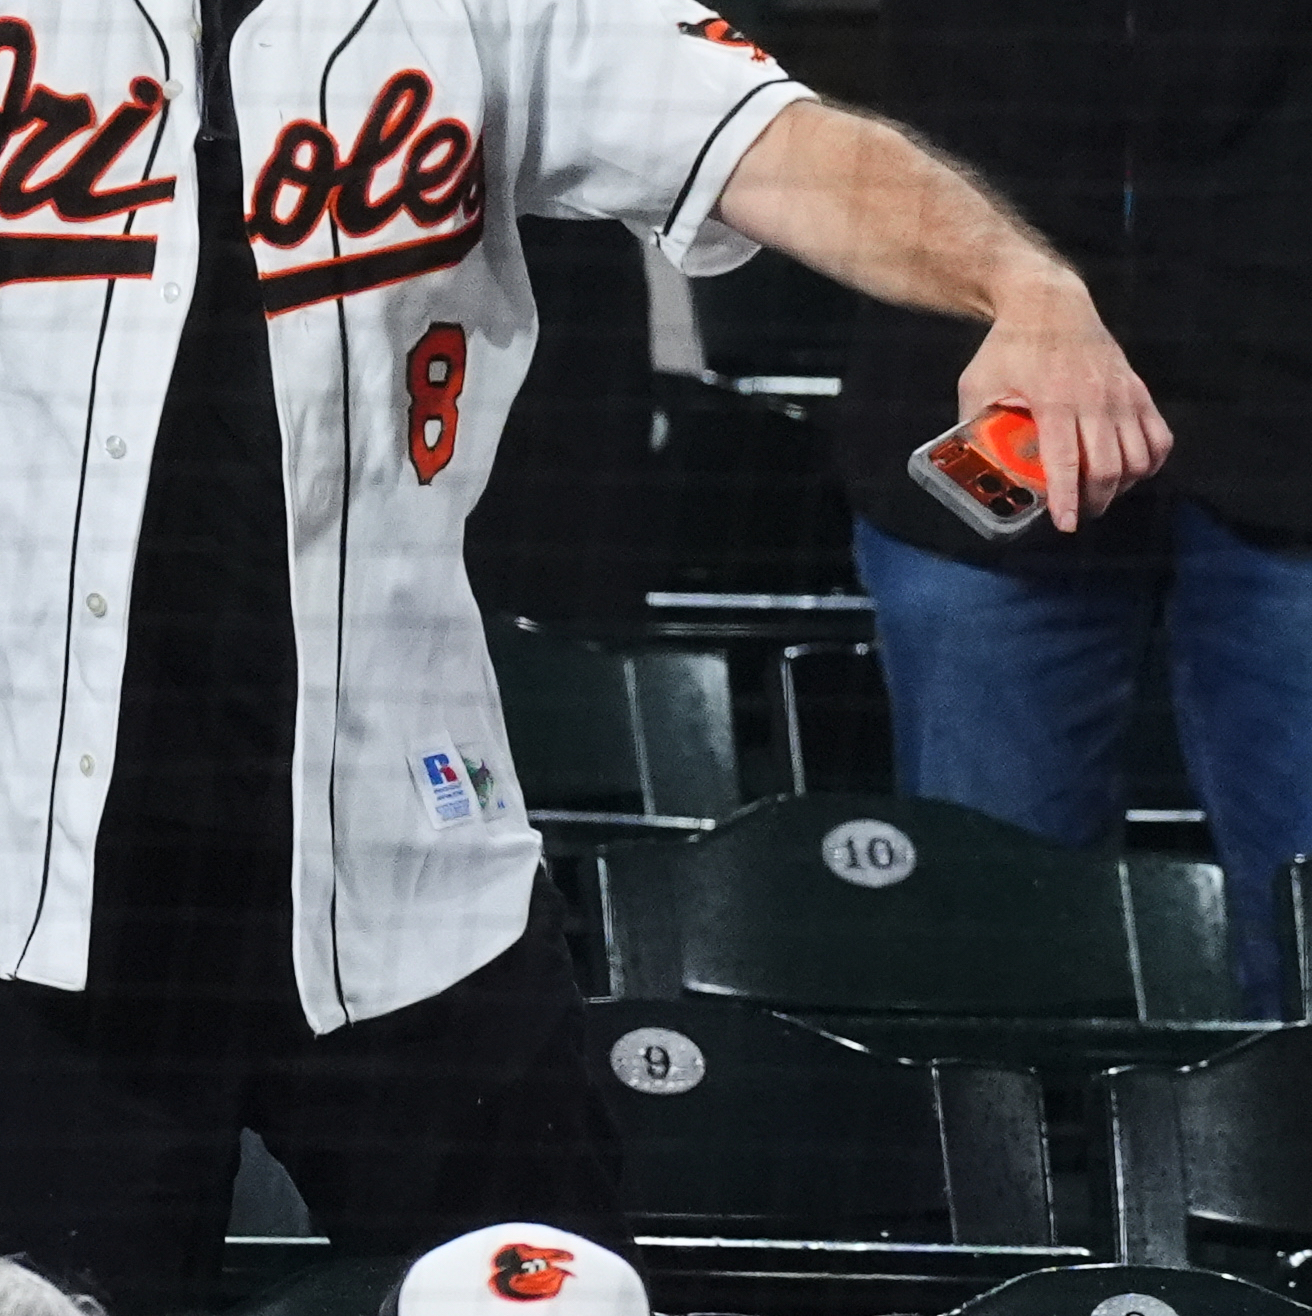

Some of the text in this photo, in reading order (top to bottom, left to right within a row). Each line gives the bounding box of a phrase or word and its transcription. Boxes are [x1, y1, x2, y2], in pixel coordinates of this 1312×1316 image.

[406, 321, 466, 486] 8
[847, 837, 894, 870] 10
[645, 1046, 670, 1080] 9
